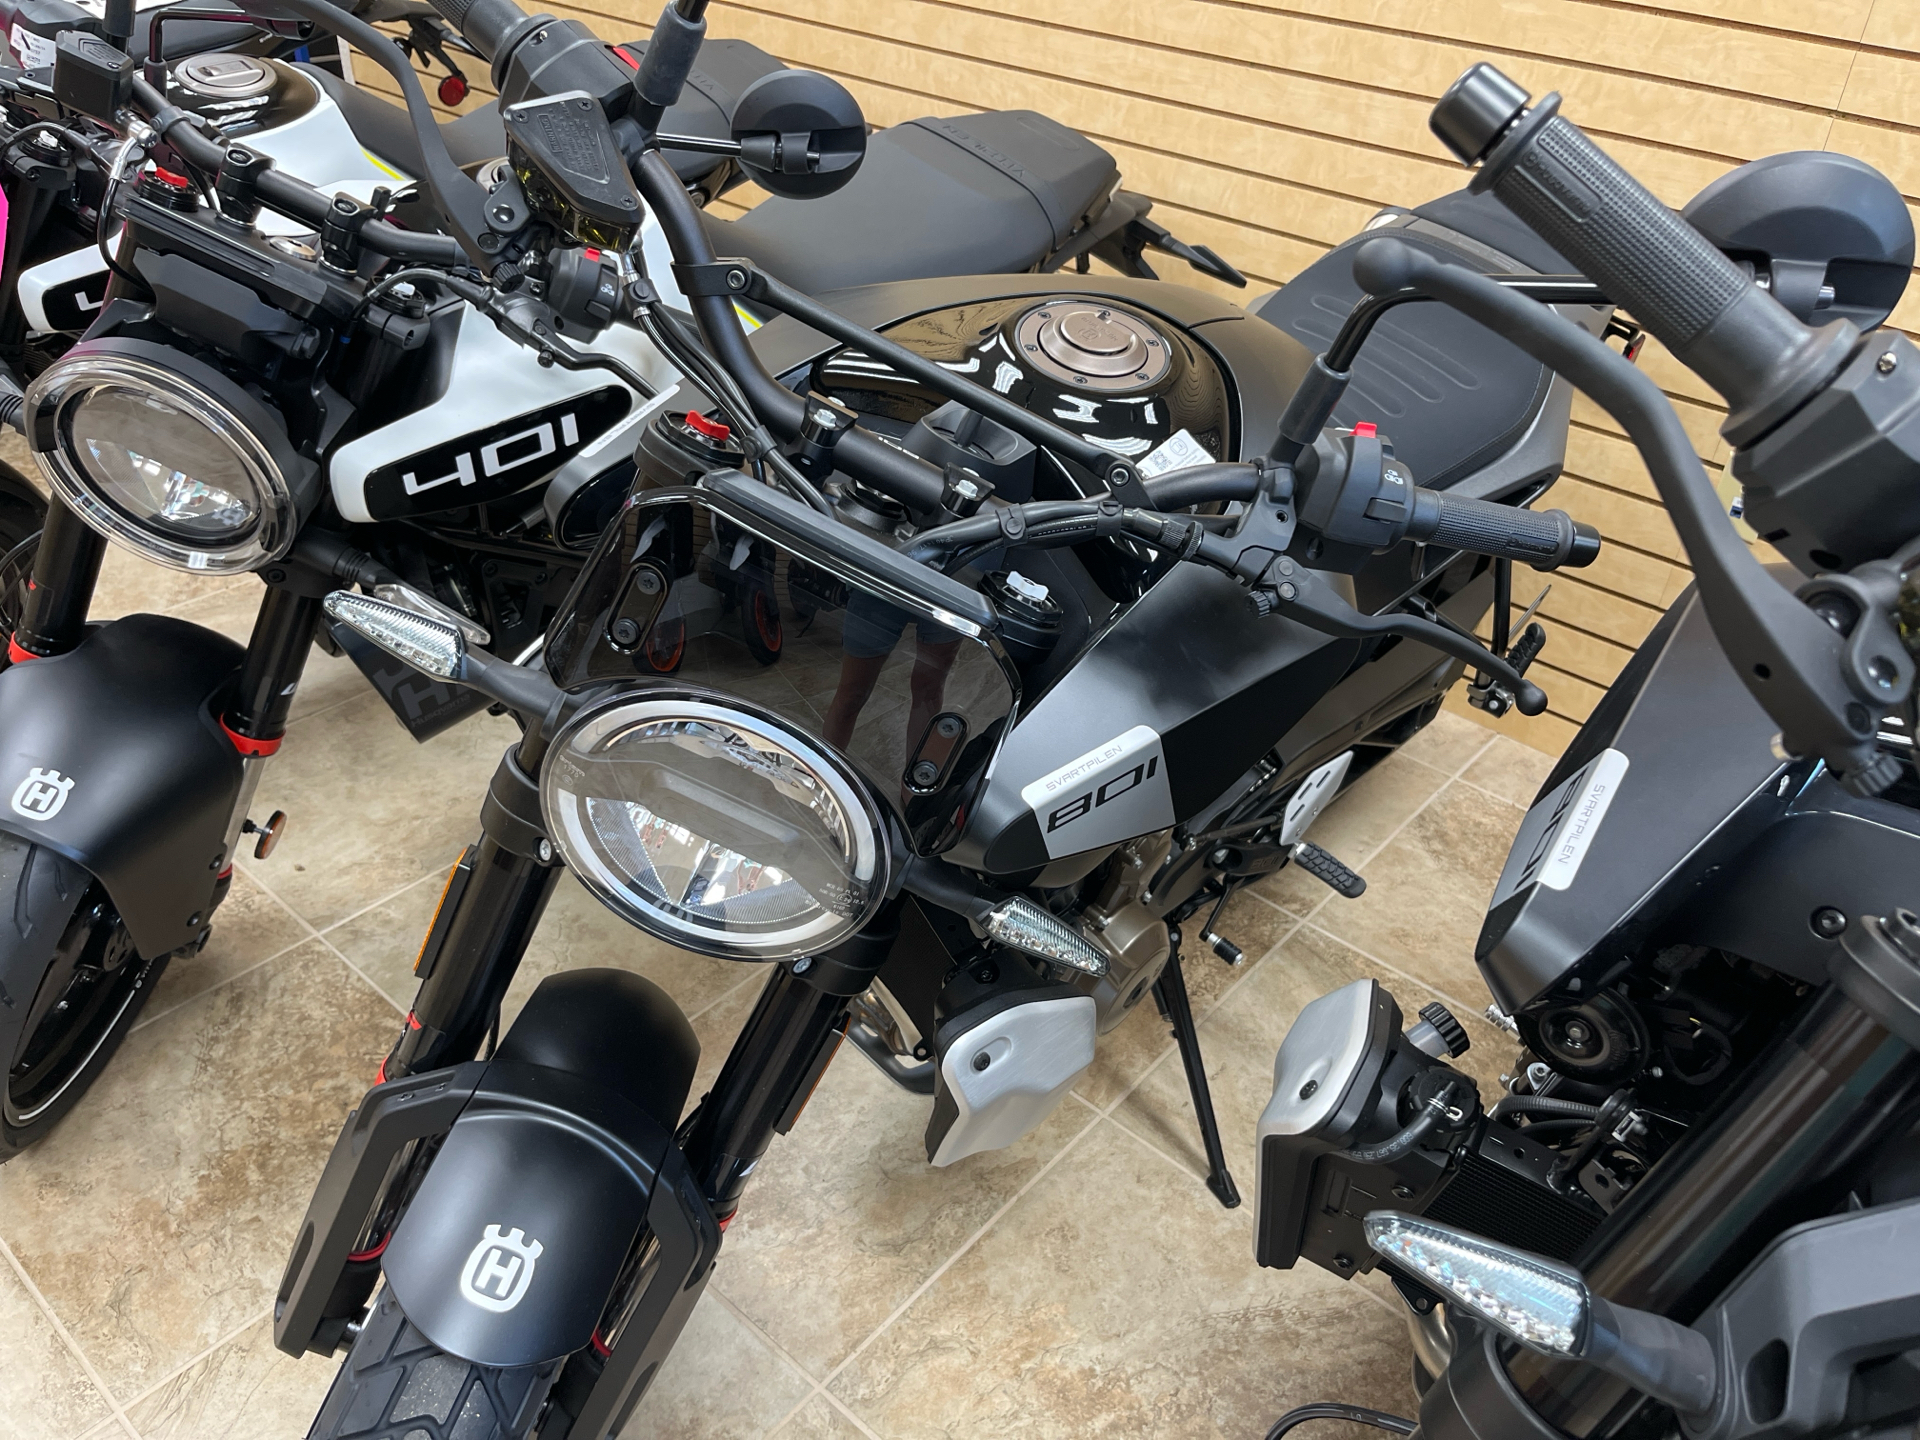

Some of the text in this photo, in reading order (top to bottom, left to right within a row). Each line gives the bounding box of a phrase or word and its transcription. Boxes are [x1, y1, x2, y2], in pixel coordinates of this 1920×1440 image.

[541, 116, 561, 152] WARNING
[402, 412, 579, 496] 401
[411, 694, 471, 727] Husqvarna
[1045, 744, 1123, 792] SVARTPILEN
[1046, 755, 1159, 834] 801
[1512, 765, 1590, 892] 801
[1558, 783, 1606, 865] SVARTPILEN
